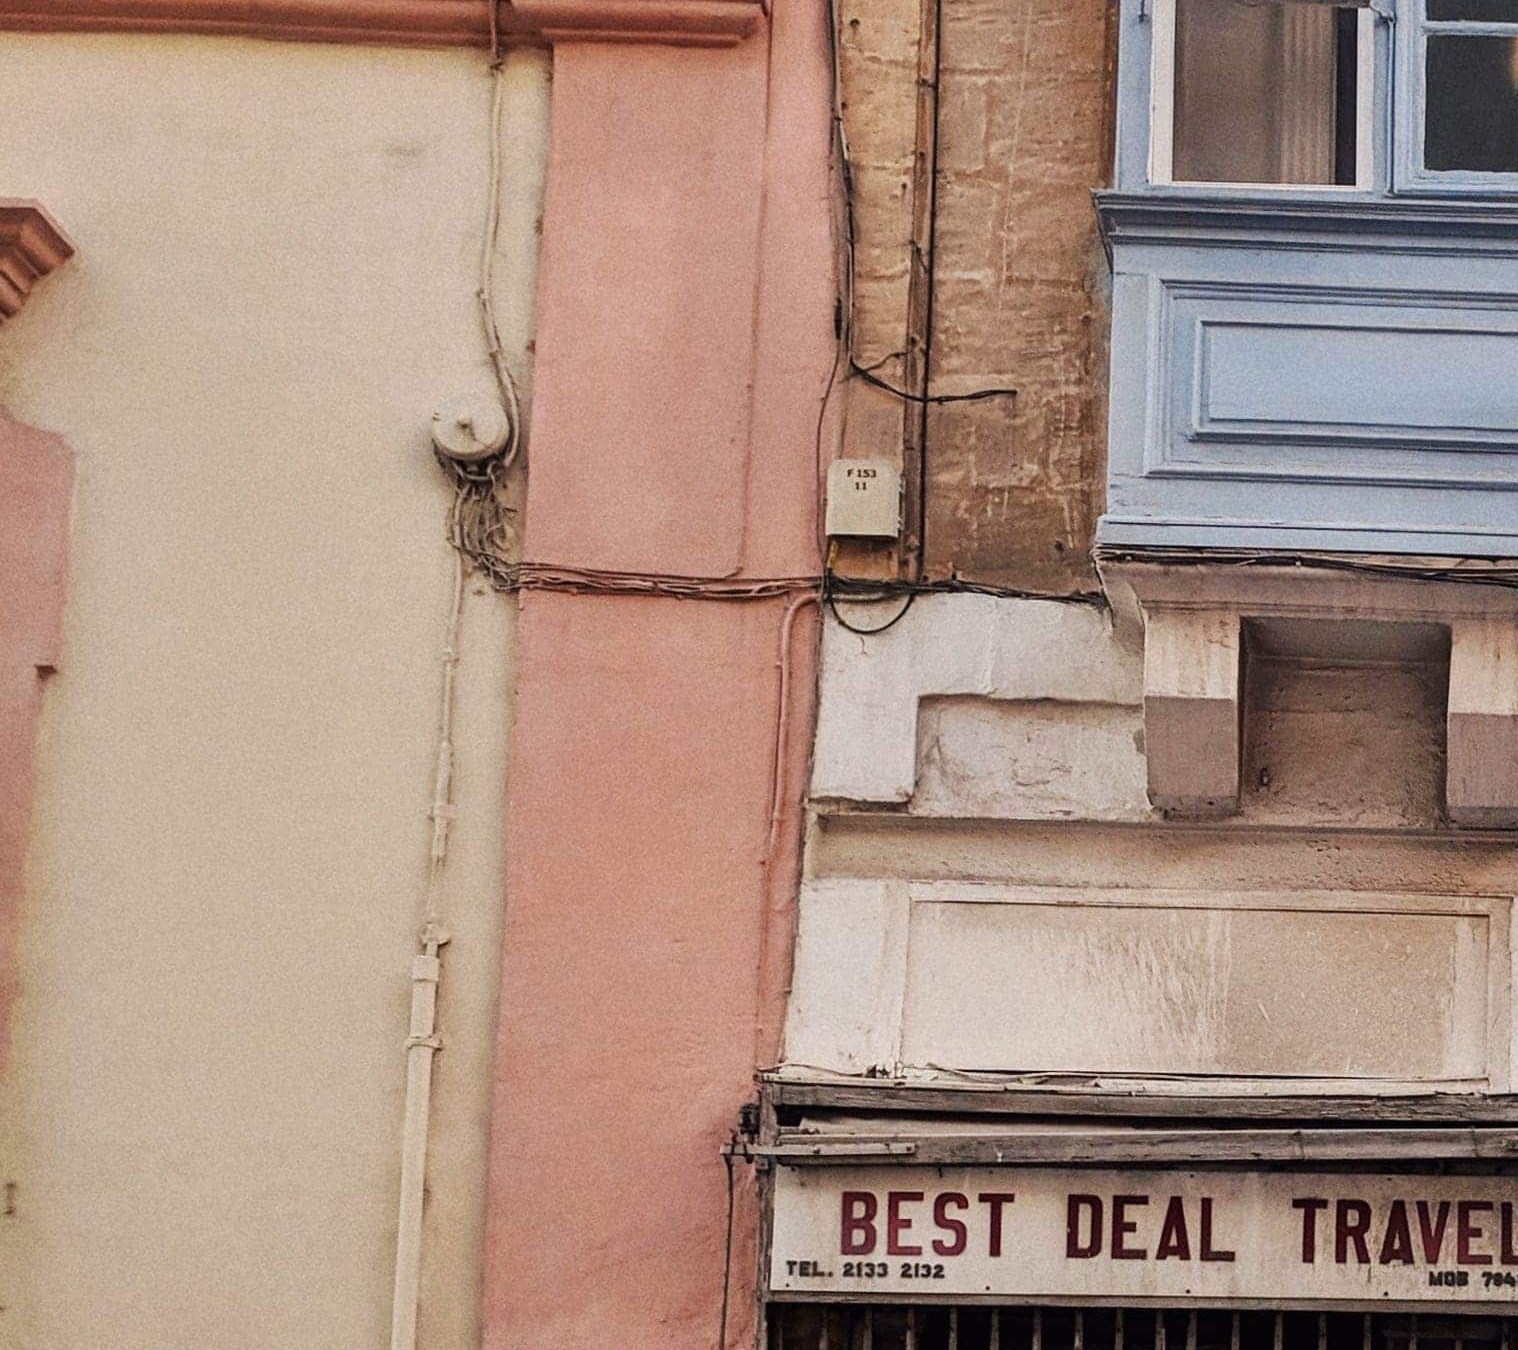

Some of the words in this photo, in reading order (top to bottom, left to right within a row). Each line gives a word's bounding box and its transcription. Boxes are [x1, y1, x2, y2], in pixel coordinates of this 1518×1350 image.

[840, 1191, 1015, 1257] BEST
[1066, 1194, 1236, 1263] DEAL
[786, 1260, 833, 1278] TEL.
[842, 1262, 889, 1278] 2133
[900, 1263, 945, 1279] 2132
[1428, 1270, 1469, 1287] MOB
